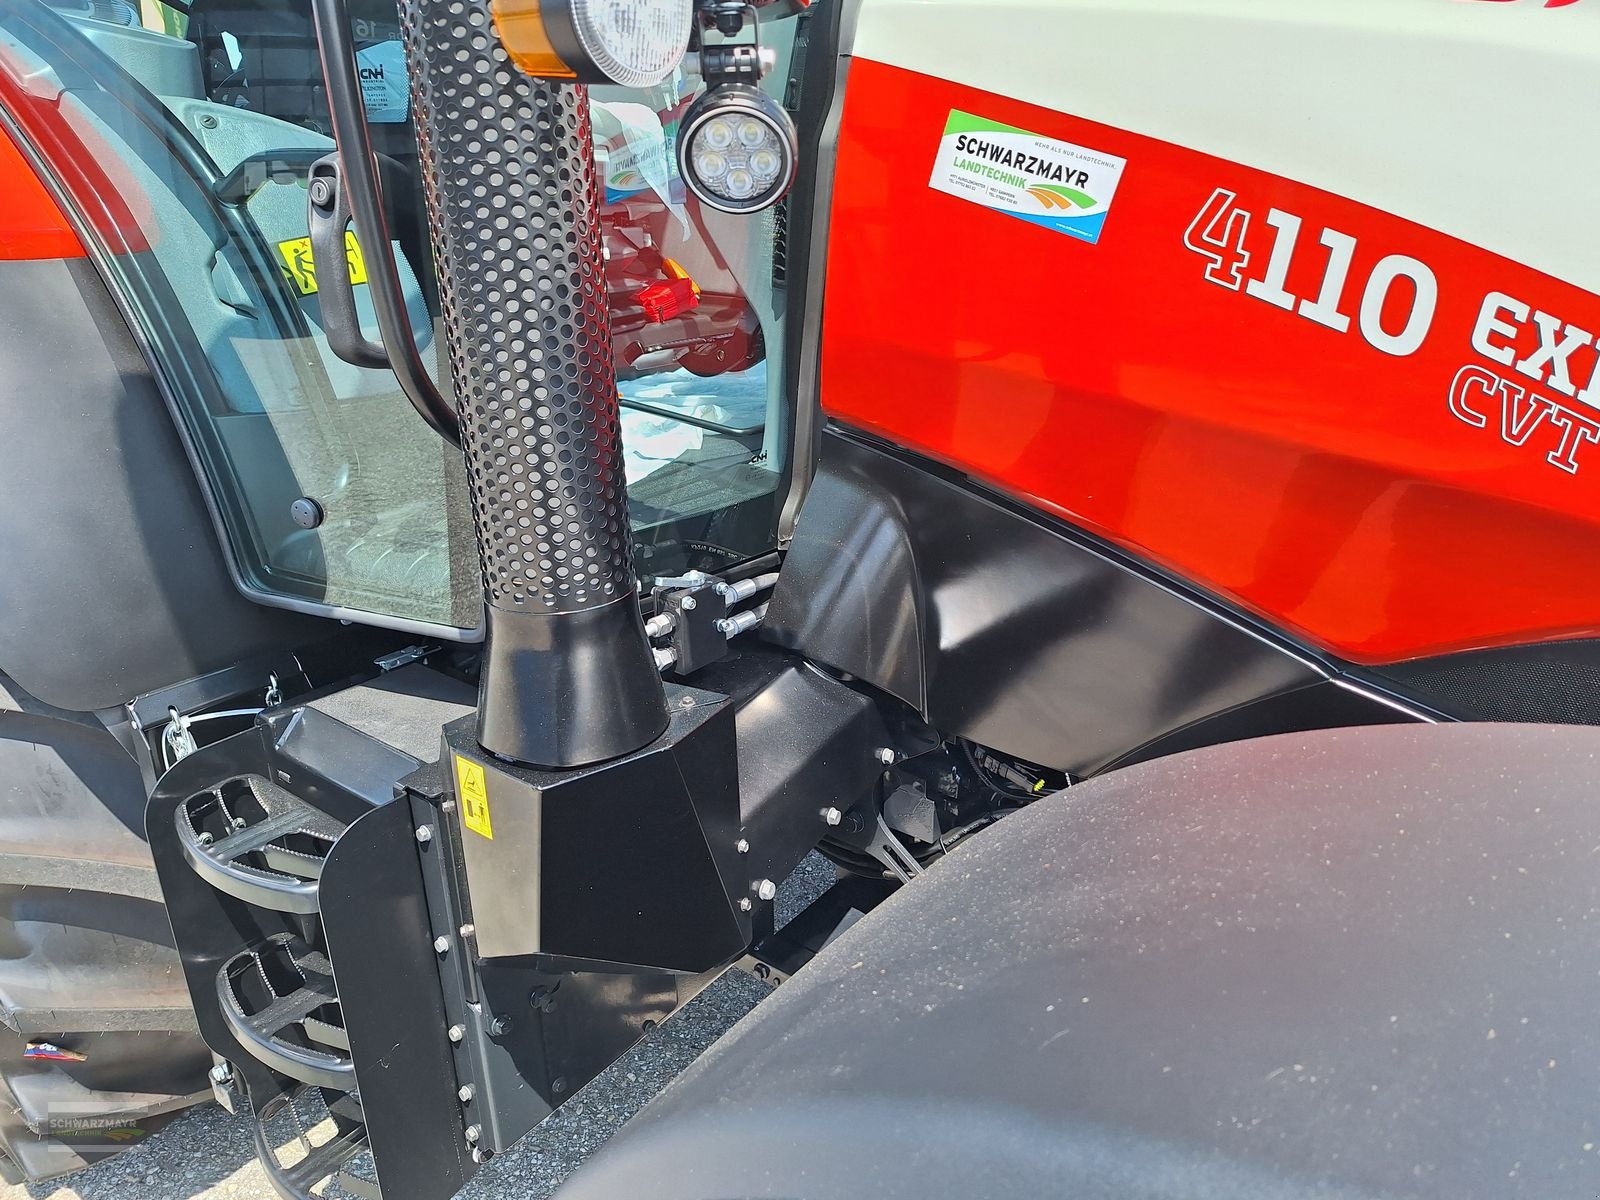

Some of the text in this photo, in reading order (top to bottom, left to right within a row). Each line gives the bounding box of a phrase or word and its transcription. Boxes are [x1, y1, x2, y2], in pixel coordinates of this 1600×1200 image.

[953, 156, 1028, 189] LANDTECHNIK
[955, 134, 1090, 189] SCHWARZMAYR
[1051, 146, 1061, 154] ALS
[1063, 149, 1075, 157] NUR
[1183, 187, 1438, 356] 4110
[1448, 364, 1600, 475] CVT
